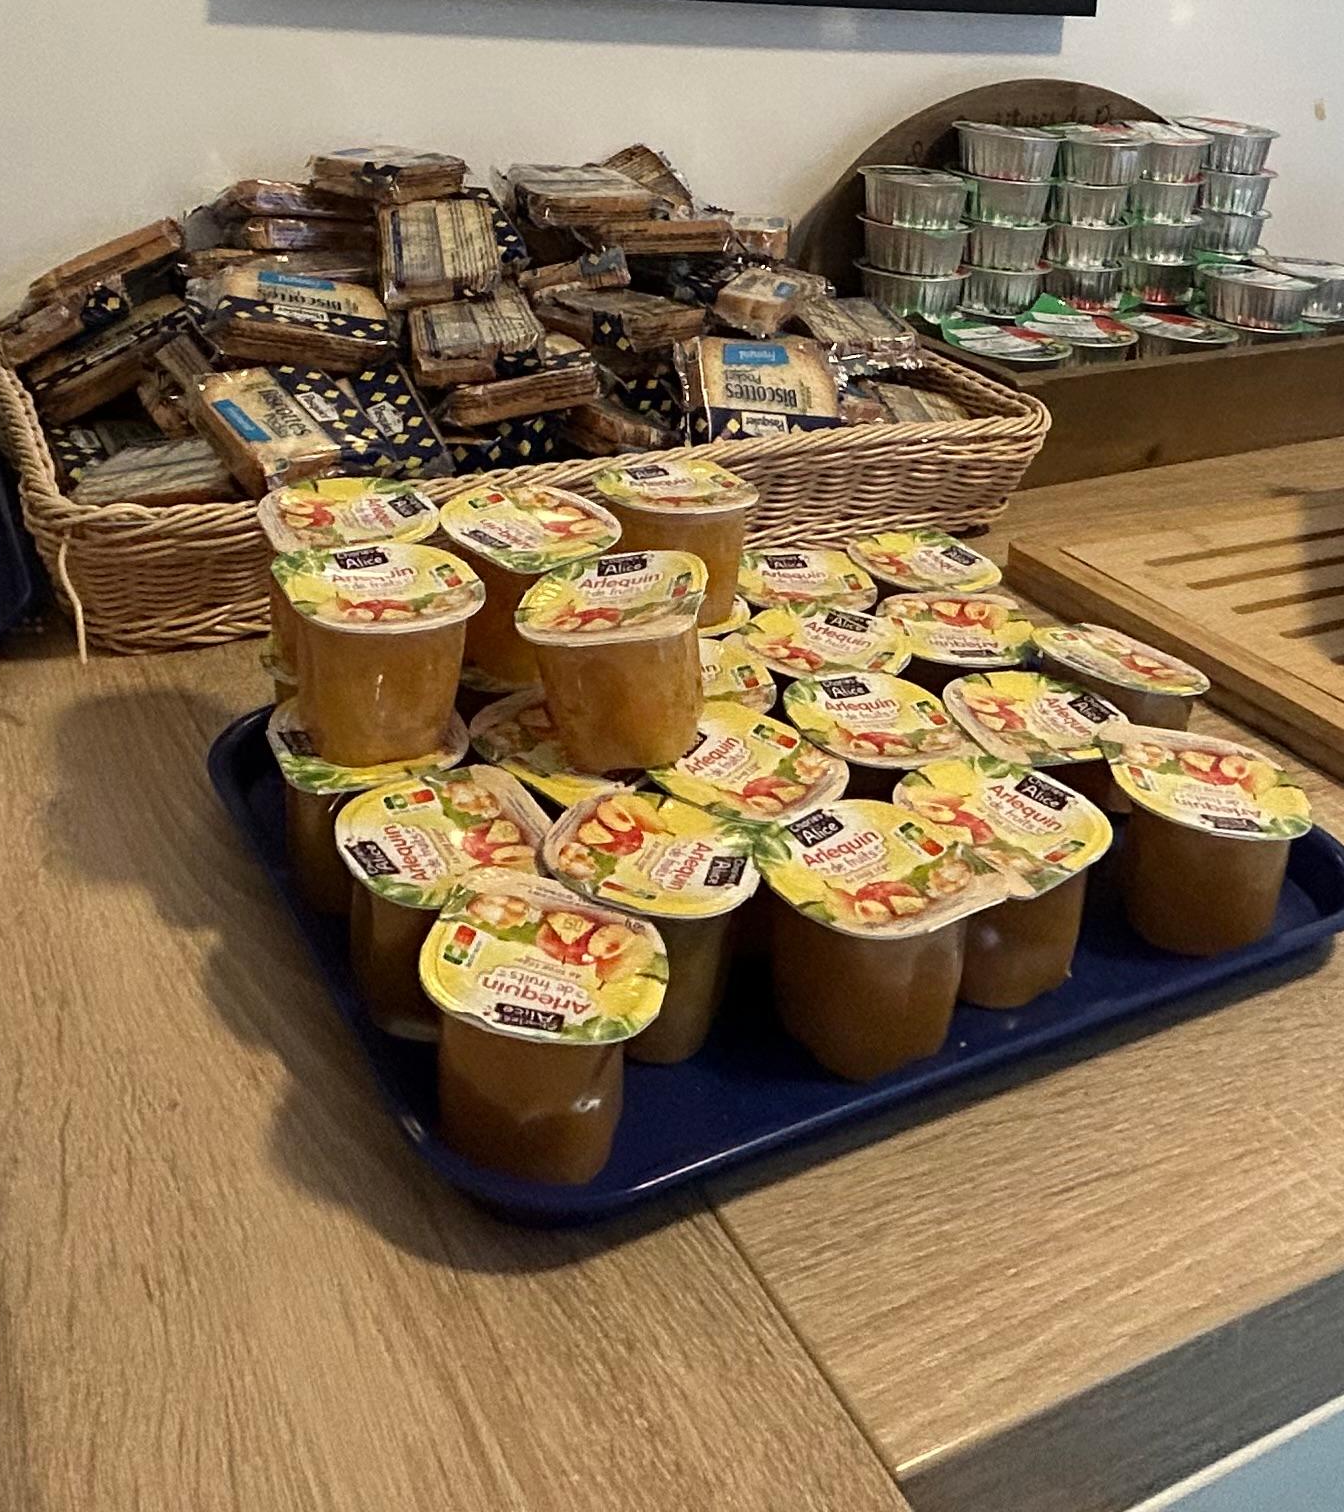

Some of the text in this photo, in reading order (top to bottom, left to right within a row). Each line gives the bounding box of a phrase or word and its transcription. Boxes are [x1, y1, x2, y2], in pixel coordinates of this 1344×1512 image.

[346, 555, 383, 569] Alice
[605, 562, 643, 575] Alice
[578, 572, 660, 591] Arlequin
[806, 620, 872, 649] Arlequin
[830, 685, 866, 699] Alice
[824, 697, 897, 714] Arlequin
[1044, 696, 1093, 737] Arlequin
[684, 736, 740, 775] Arlequin
[990, 783, 1063, 831] Arlequin
[1022, 784, 1062, 809] Alice
[801, 821, 838, 846] Alice
[383, 824, 431, 882] Arlequin
[801, 828, 880, 868] Arlequin
[664, 842, 713, 890] Arlequin
[509, 970, 550, 992] fruits
[481, 976, 592, 1016] Arlequin
[503, 1005, 555, 1023] Alice
